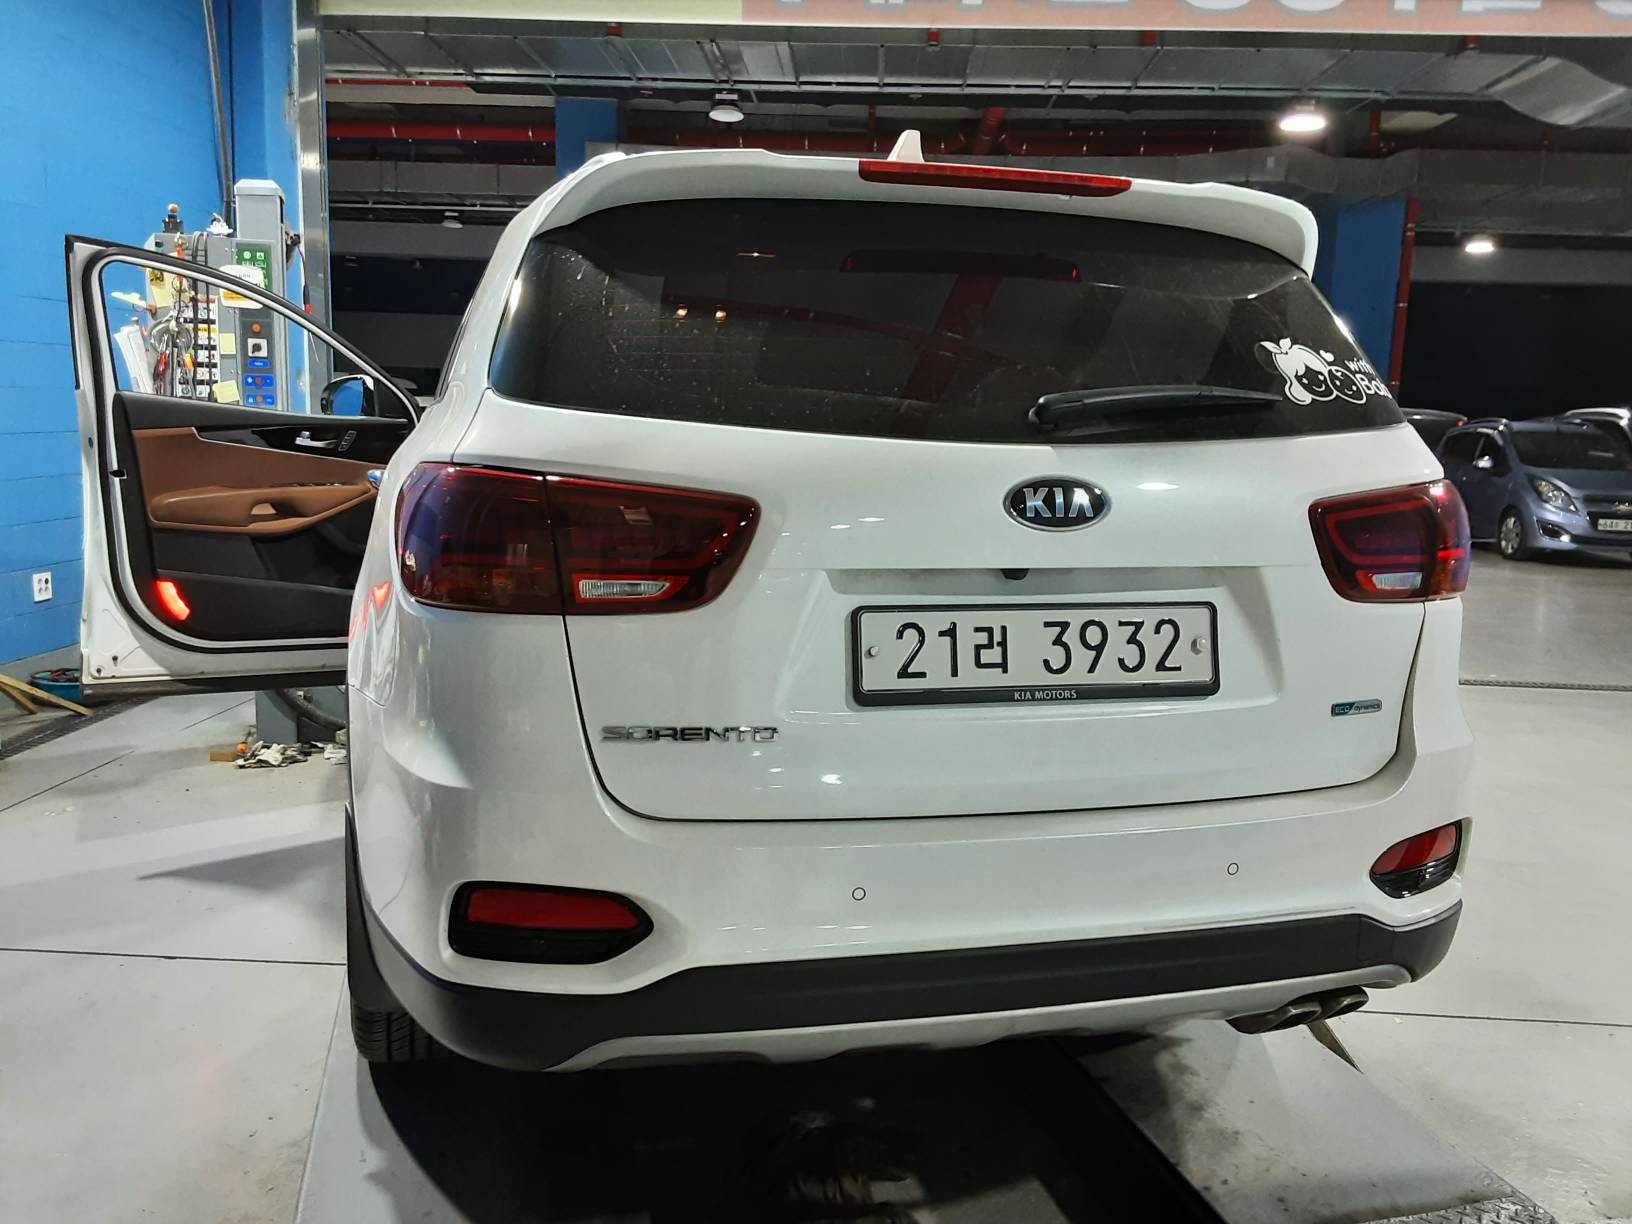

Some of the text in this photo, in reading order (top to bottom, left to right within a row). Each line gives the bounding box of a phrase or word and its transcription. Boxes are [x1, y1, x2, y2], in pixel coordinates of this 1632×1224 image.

[1022, 487, 1094, 518] KIA
[895, 618, 1182, 679] 21러 3932
[1014, 689, 1077, 700] KIA MOTORS
[600, 726, 779, 742] SORENTO
